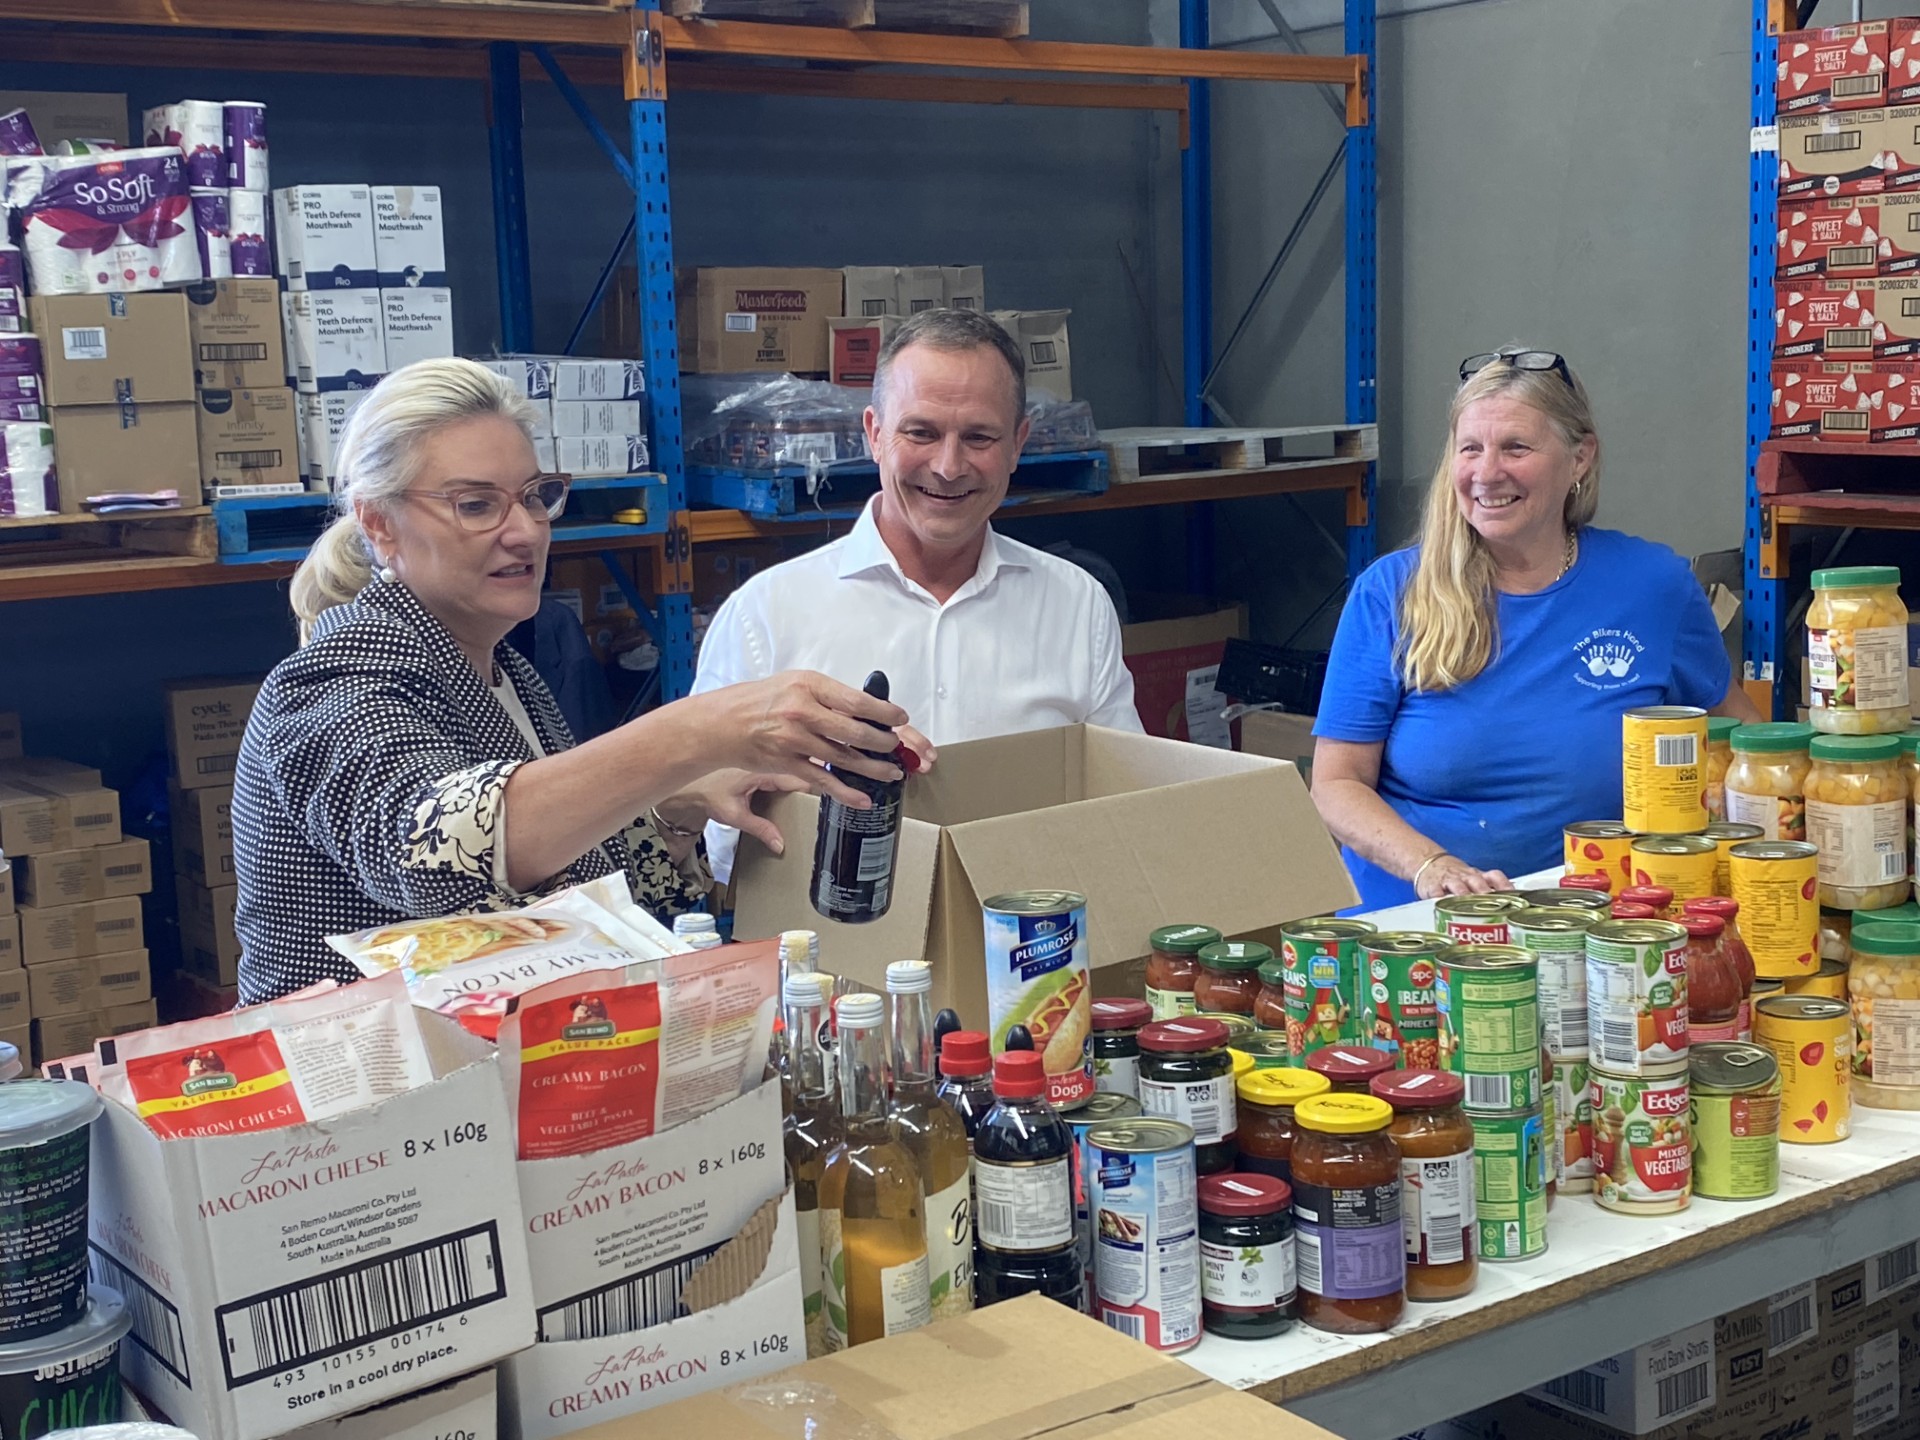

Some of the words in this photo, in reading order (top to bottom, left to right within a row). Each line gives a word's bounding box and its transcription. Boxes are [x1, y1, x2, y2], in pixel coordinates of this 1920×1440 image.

[1814, 50, 1847, 63] SWEET
[1814, 64, 1822, 72] &
[1824, 60, 1846, 71] SALTY
[1782, 116, 1819, 129] 320032762
[164, 157, 178, 169] 24
[97, 206, 105, 215] &
[108, 203, 139, 214] Strong
[304, 202, 321, 210] PRO
[330, 210, 361, 218] Defence
[306, 220, 352, 230] Mouthwash
[379, 222, 423, 231] Mouthwash
[1812, 220, 1843, 232] SWEET
[1812, 232, 1818, 240] &
[1820, 230, 1842, 240] SALTY
[1878, 280, 1918, 290] 320032762
[316, 308, 333, 316] PRO
[388, 304, 404, 312] PRO
[1808, 302, 1840, 313] SWEET
[318, 318, 340, 326] Teeth
[342, 316, 373, 324] Defence
[389, 314, 410, 322] Teeth
[411, 312, 442, 322] Defence
[1809, 314, 1815, 322] &
[1817, 312, 1838, 321] SALTY
[318, 326, 364, 336] Mouthwash
[389, 323, 432, 332] Mouthwash
[1784, 344, 1816, 356] CORNERS
[1884, 344, 1912, 355] CORNERS
[1806, 384, 1837, 394] SWEET
[1814, 394, 1836, 404] SALTY
[227, 420, 264, 431] Infinity
[1781, 424, 1812, 436] CORNERS
[1884, 428, 1918, 439] CORNERS
[1573, 637, 1591, 652] The
[1592, 628, 1621, 640] Bikers
[1622, 630, 1646, 652] Hand
[192, 702, 232, 718] cycle
[193, 722, 215, 732] Ultra
[218, 720, 238, 729] Thin
[194, 733, 214, 742] Pads
[216, 732, 228, 740] no
[1015, 928, 1074, 963] PLUMROSE
[1314, 966, 1334, 978] WIN
[1412, 970, 1432, 982] spc
[443, 964, 536, 998] BACON
[326, 1005, 378, 1026] DIRECTIONS
[569, 1027, 588, 1036] SAN
[588, 1026, 609, 1035] REMO
[551, 1039, 590, 1052] VALUE
[598, 1036, 631, 1048] PACK
[533, 1071, 595, 1088] CREAMY
[600, 1063, 648, 1082] BACON
[189, 1079, 206, 1090] SAN
[207, 1078, 228, 1088] REMO
[1051, 1082, 1084, 1099] Dogs
[171, 1092, 214, 1109] VALUE
[222, 1084, 256, 1098] PACK
[238, 1103, 296, 1128] CHEESE
[572, 1110, 596, 1122] BEEF
[540, 1119, 599, 1136] VEGETABLE
[604, 1109, 634, 1122] PASTA
[404, 1140, 416, 1158] 8
[422, 1138, 436, 1154] x
[444, 1122, 488, 1148] 160g
[283, 1137, 341, 1168] Pasta
[698, 1160, 708, 1174] 8
[714, 1158, 724, 1171] x
[731, 1142, 765, 1164] 160g
[1658, 1145, 1688, 1160] MIXED
[600, 1157, 648, 1186] Pasta
[198, 1174, 308, 1220] MACARONI
[314, 1149, 392, 1186] CHEESE
[529, 1193, 611, 1234] CREAMY
[620, 1167, 688, 1204] BACON
[282, 1222, 298, 1236] San
[301, 1216, 327, 1230] Remo
[328, 1202, 370, 1221] Macaroni
[386, 1193, 400, 1206] Pty
[402, 1188, 417, 1200] Ltd
[280, 1240, 288, 1248] 4
[288, 1232, 318, 1248] Boden
[320, 1224, 347, 1240] Court,
[348, 1212, 384, 1230] Windsor
[386, 1200, 422, 1218] Gardens
[595, 1234, 610, 1244] San
[612, 1227, 633, 1240] Remo
[634, 1214, 668, 1233] Macaroni
[668, 1210, 679, 1220] Co.
[680, 1205, 692, 1217] Pty
[694, 1200, 706, 1210] Ltd
[287, 1246, 314, 1262] South
[316, 1233, 358, 1254] Australia,
[358, 1222, 396, 1241] Australia
[398, 1214, 418, 1228] 5087
[600, 1242, 624, 1255] Boden
[648, 1222, 678, 1239] Windsor
[679, 1210, 708, 1227] Gardens
[320, 1251, 344, 1265] Made
[346, 1248, 354, 1257] in
[356, 1237, 392, 1254] Australia
[598, 1253, 620, 1268] South
[656, 1230, 687, 1246] Australia
[624, 1258, 642, 1269] Made
[644, 1254, 652, 1263] in
[652, 1244, 682, 1260] Australia
[1206, 1261, 1224, 1272] MINT
[1206, 1271, 1225, 1281] JELLY
[1832, 1284, 1861, 1308] VISY
[1733, 1315, 1763, 1340] Mills
[274, 1368, 306, 1389] 493
[322, 1344, 376, 1373] 10155
[391, 1324, 445, 1350] 00174
[460, 1314, 468, 1326] 6
[720, 1350, 730, 1366] 8
[736, 1349, 746, 1362] x
[752, 1334, 789, 1356] 160g
[620, 1343, 668, 1372] Pasta
[1648, 1354, 1668, 1376] Food
[1668, 1346, 1684, 1368] Bank
[1686, 1340, 1709, 1360] Shorts
[1732, 1354, 1762, 1376] VISY
[287, 1389, 326, 1410] Store
[330, 1382, 342, 1396] in
[346, 1380, 354, 1390] a
[358, 1365, 388, 1385] cool
[392, 1358, 414, 1374] dry
[417, 1344, 458, 1366] place.
[549, 1378, 633, 1418] CREAMY
[640, 1356, 708, 1392] BACON
